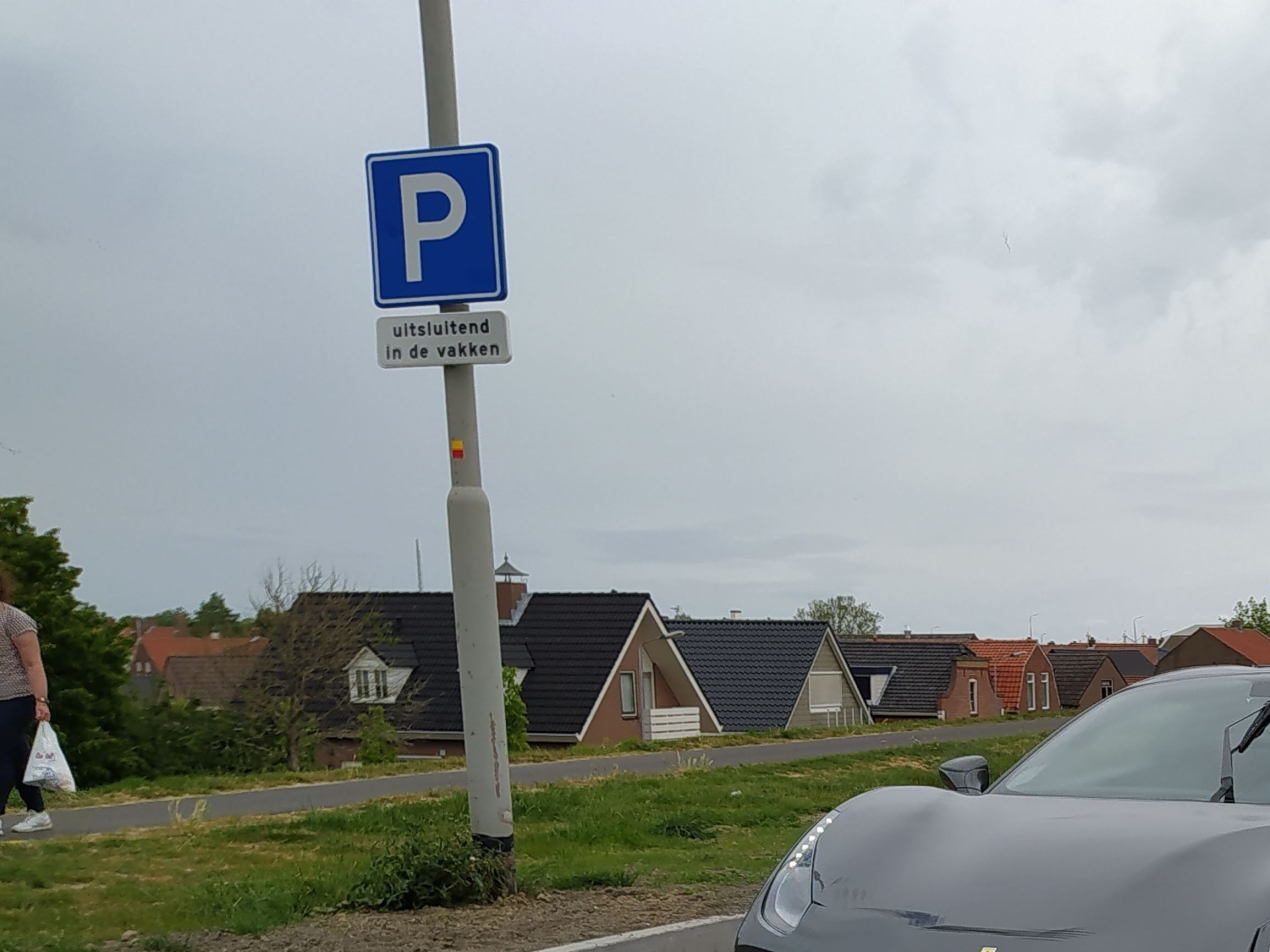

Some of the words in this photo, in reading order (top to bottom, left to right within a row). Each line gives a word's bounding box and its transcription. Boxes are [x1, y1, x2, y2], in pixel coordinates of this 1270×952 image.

[399, 172, 467, 282] P
[392, 318, 489, 337] uitsluitend
[386, 344, 402, 360] in
[409, 344, 429, 359] de
[437, 342, 500, 358] vakken
